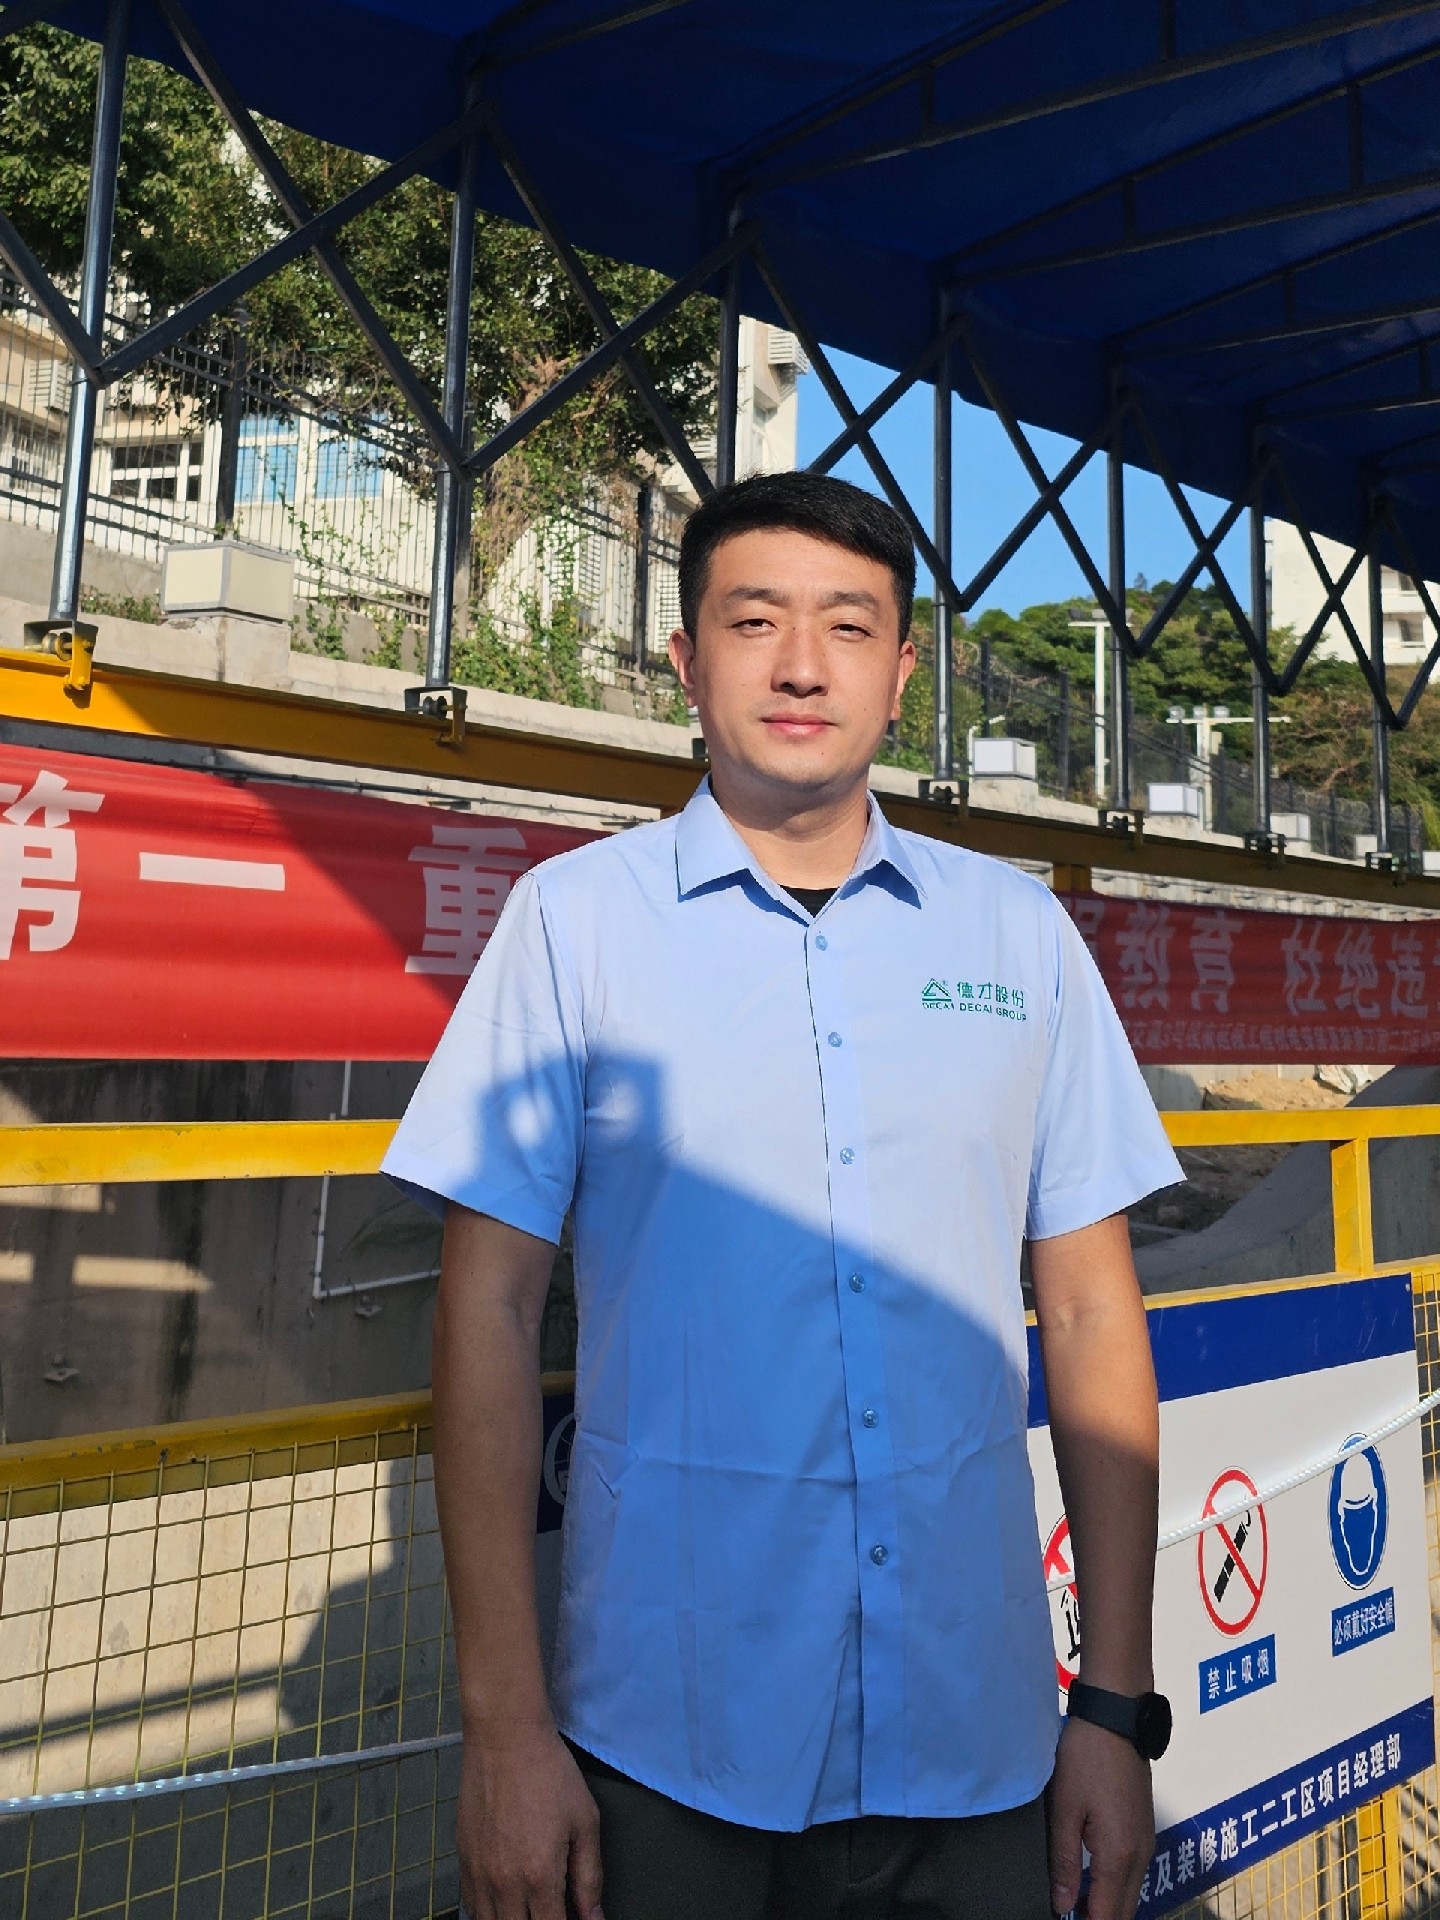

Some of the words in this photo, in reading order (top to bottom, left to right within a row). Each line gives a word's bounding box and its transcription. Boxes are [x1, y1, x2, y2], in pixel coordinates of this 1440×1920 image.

[0, 770, 286, 960] 第一
[1280, 919, 1440, 1021] 杜绝违
[956, 981, 1024, 1009] 德才股份
[959, 1002, 992, 1014] DECAI
[996, 1007, 1027, 1022] GROUP
[1206, 1648, 1271, 1701] 禁止吸烟
